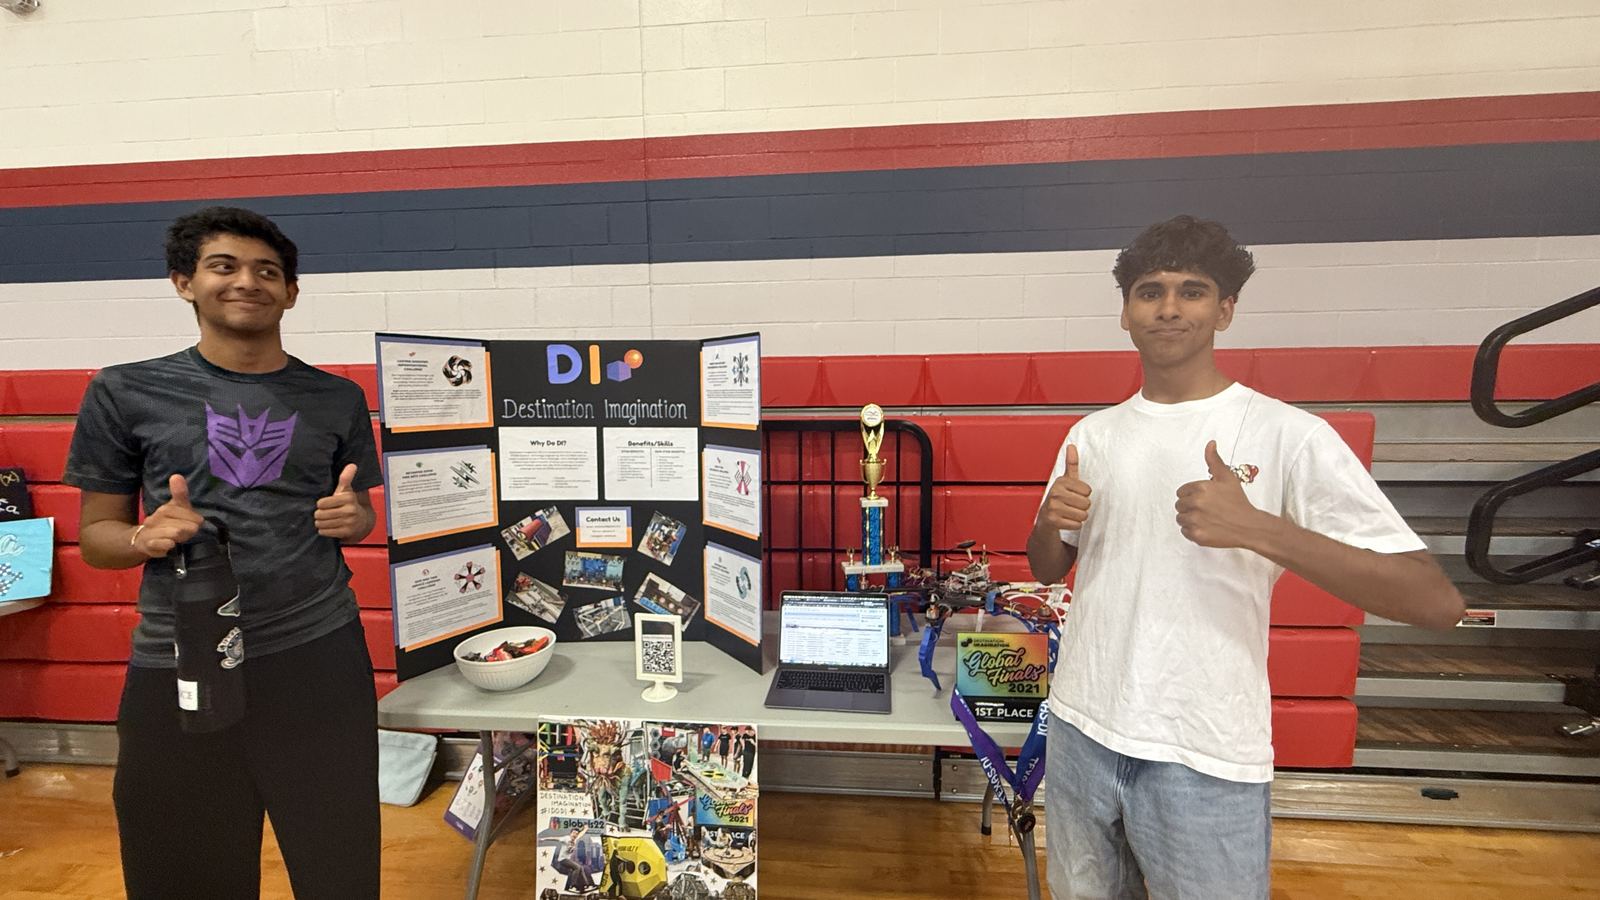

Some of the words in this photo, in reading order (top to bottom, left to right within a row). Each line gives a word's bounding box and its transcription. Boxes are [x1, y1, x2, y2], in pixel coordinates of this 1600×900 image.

[547, 344, 601, 385] DI
[501, 398, 595, 419] Destination
[604, 398, 688, 425] Imagination
[963, 647, 1026, 677] Global
[986, 664, 1046, 687] Finals
[1008, 683, 1040, 693] 2021
[975, 707, 993, 717] 1ST
[997, 708, 1034, 718] PLACE
[540, 793, 584, 801] DESTINATION
